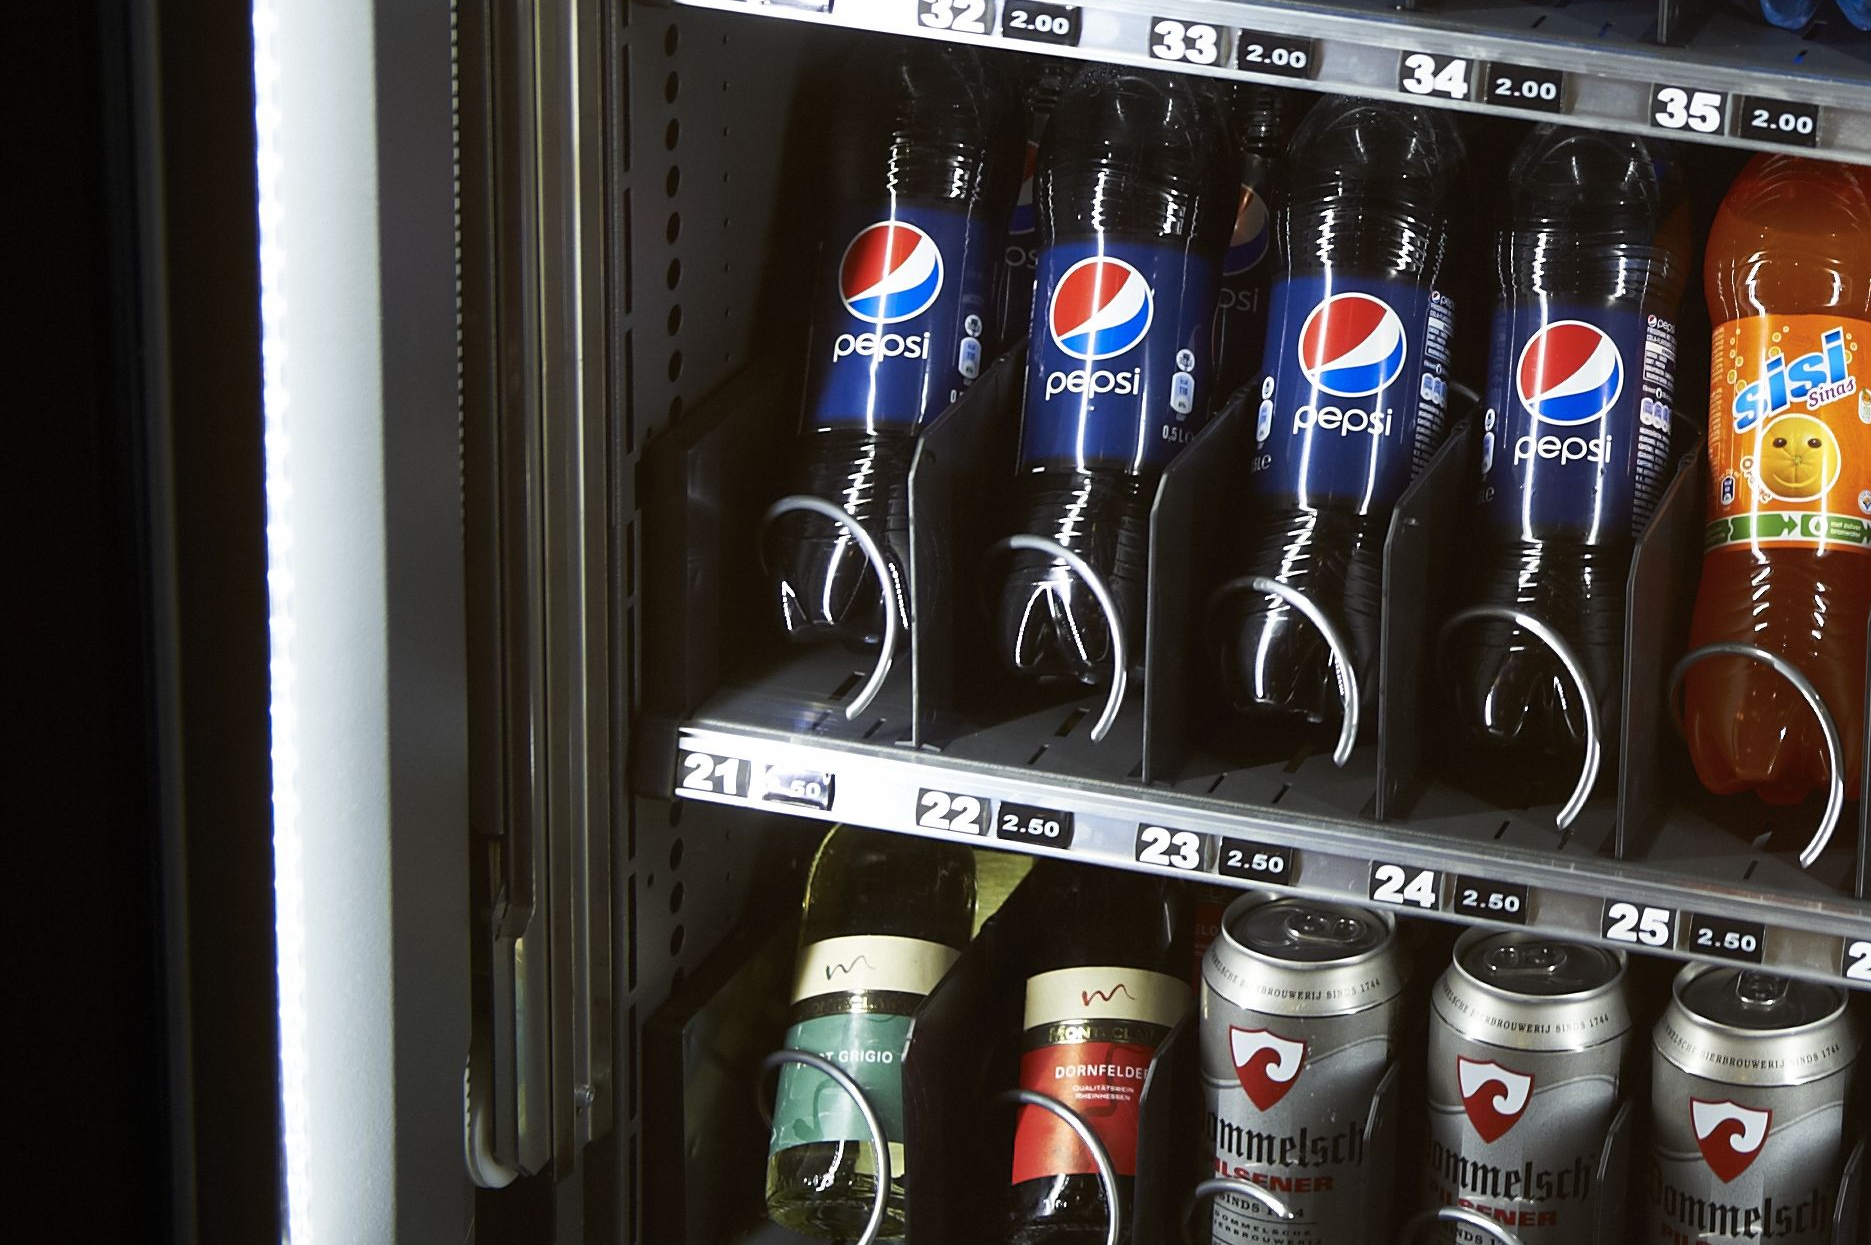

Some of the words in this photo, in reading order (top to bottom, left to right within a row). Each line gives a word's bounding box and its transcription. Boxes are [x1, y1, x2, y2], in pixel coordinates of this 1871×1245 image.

[1009, 9, 1071, 36] 2.00
[1151, 20, 1218, 66] 33
[1245, 44, 1306, 69] 2.00
[1402, 53, 1468, 99] 34
[1495, 76, 1557, 101] 2.00
[1654, 87, 1722, 134] 35
[1751, 108, 1814, 135] 2.00
[833, 331, 931, 363] pepsi
[1045, 368, 1141, 401] pepsi
[1733, 327, 1850, 433] sisi
[1808, 377, 1855, 408] Sinas
[1291, 403, 1393, 437] pepsi
[1513, 434, 1612, 465] pepsi
[682, 752, 739, 796] 21
[918, 789, 983, 835] 22
[1001, 813, 1060, 839] 2.50
[1138, 825, 1200, 872] 23
[1226, 849, 1285, 875] 2.50
[1372, 863, 1437, 908] 24
[1461, 888, 1521, 913] 2.50
[1605, 903, 1671, 947] 25
[1697, 928, 1757, 953] 2.50
[1589, 1013, 1610, 1029] 1744
[838, 1049, 893, 1064] GRIGIO
[1207, 1111, 1369, 1168] ommelsch
[1432, 1139, 1593, 1204] ommelsch
